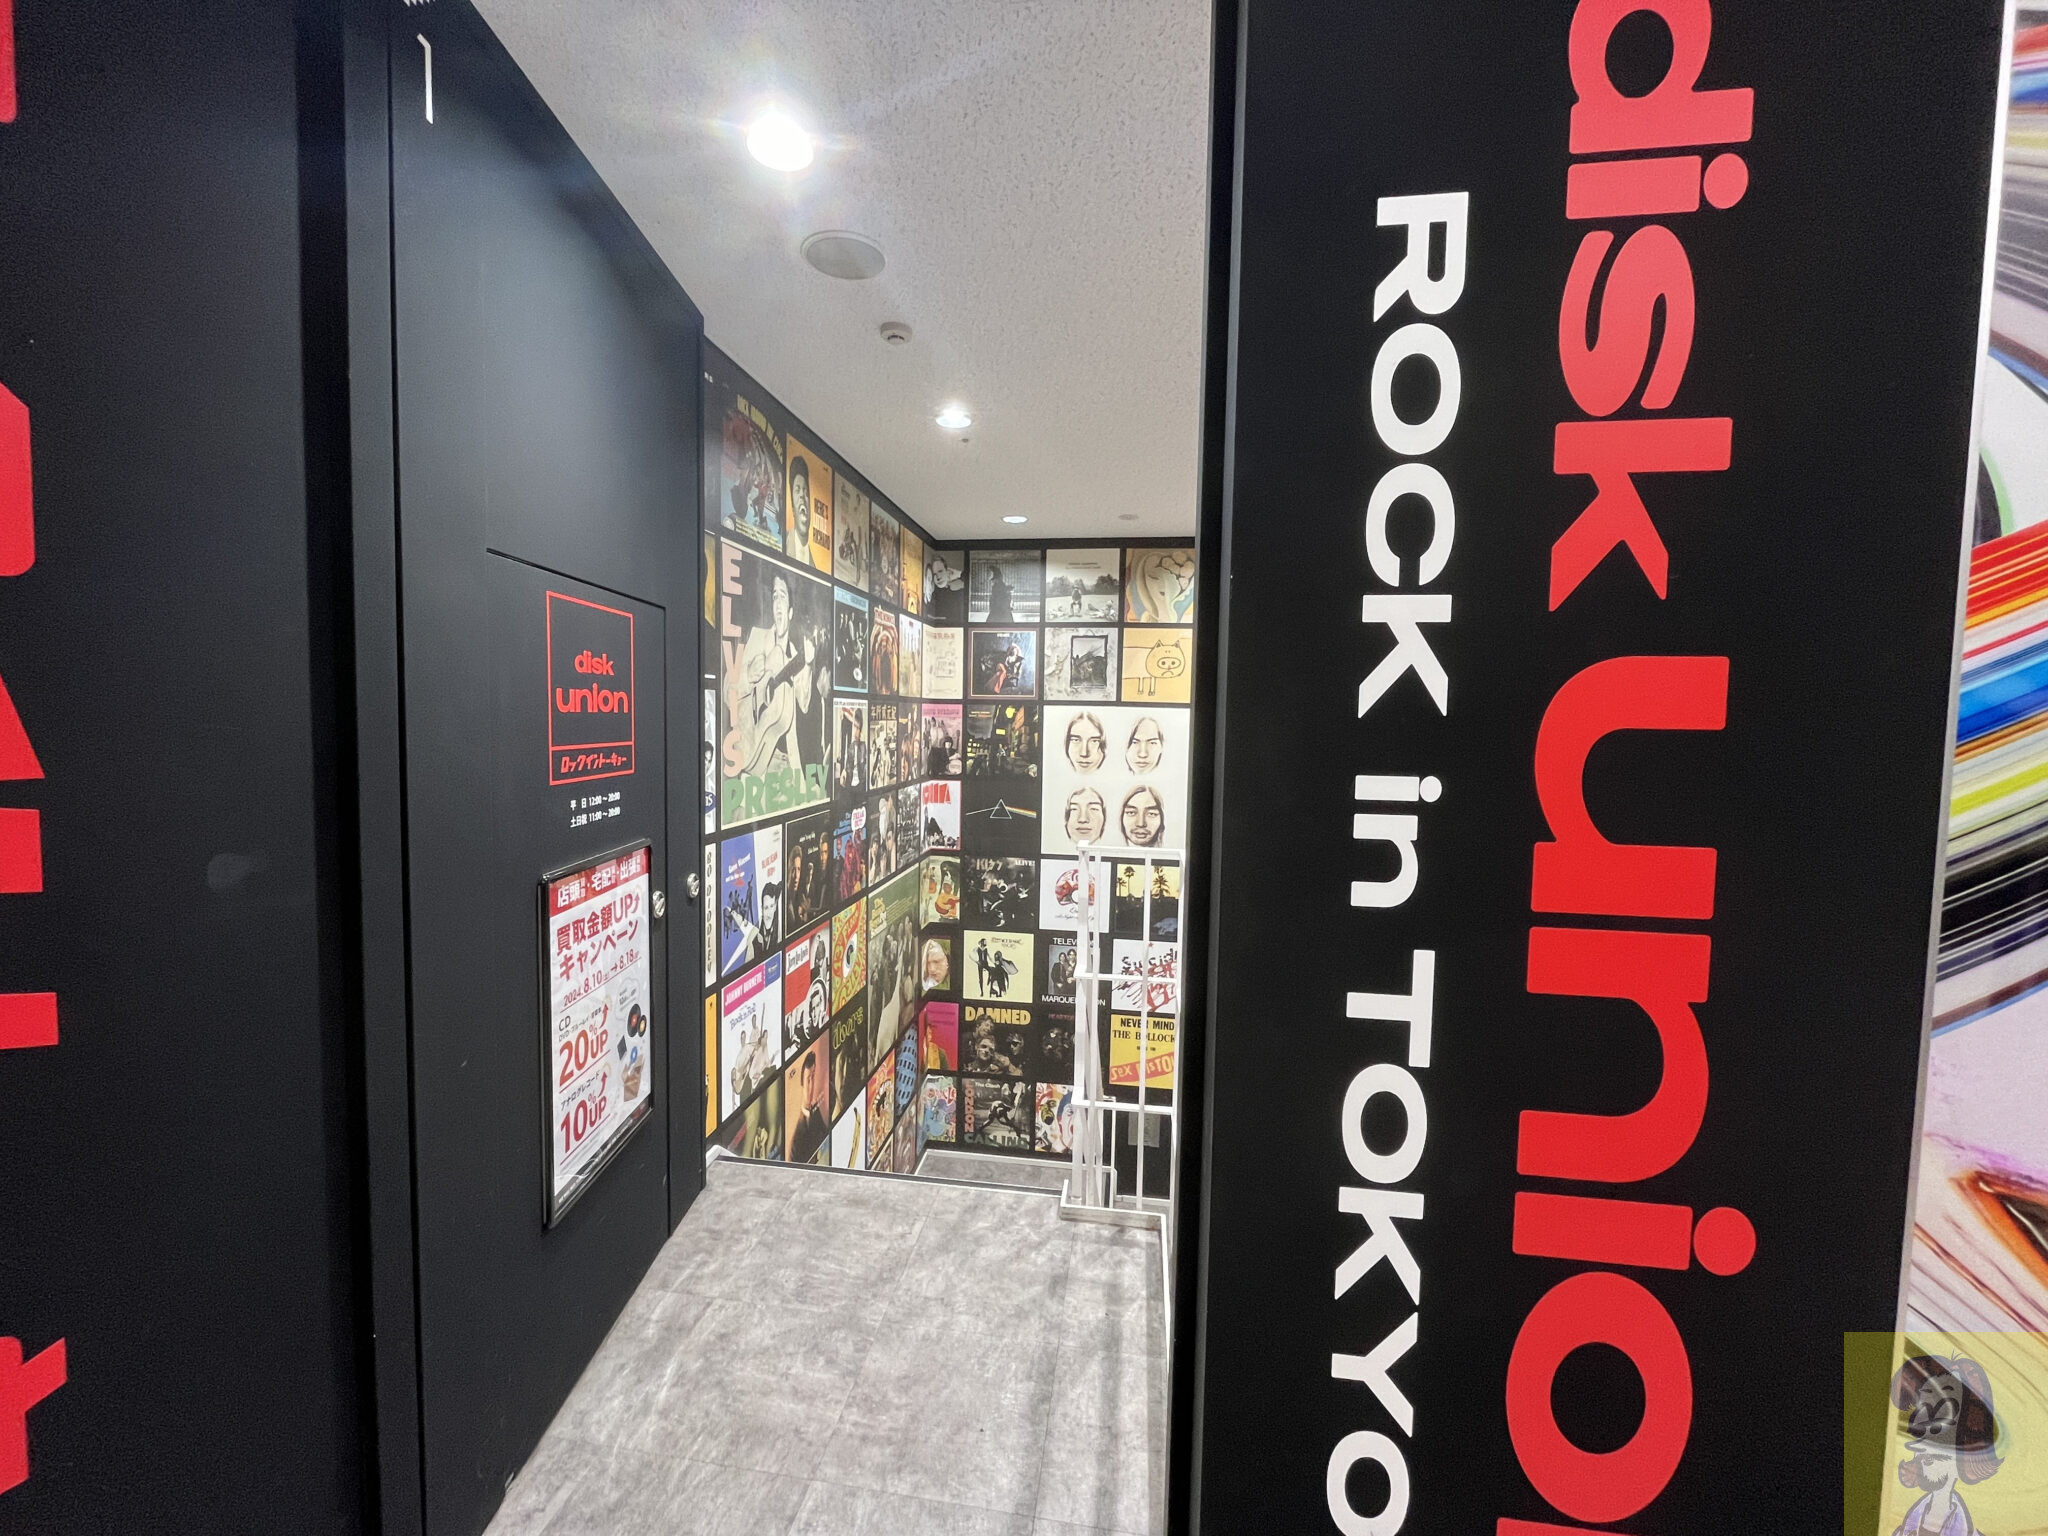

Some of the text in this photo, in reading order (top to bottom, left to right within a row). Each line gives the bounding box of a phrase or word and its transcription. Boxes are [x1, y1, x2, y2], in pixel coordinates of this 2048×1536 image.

[574, 650, 614, 675] disk
[722, 543, 744, 778] ELVIS
[556, 683, 629, 713] union
[1496, 0, 1756, 1536] disk unio
[723, 763, 829, 825] PRESLEY
[976, 858, 1003, 871] KISS
[1327, 192, 1470, 1536] ROCK in TOKYO
[560, 920, 638, 982] キャンペーン
[1053, 937, 1077, 946] TELEV
[725, 984, 743, 1007] JOHNNY
[1041, 994, 1076, 1004] MARQUE
[559, 1015, 571, 1032] CD
[833, 1006, 864, 1050] doors
[965, 1006, 1031, 1026] DAMNED
[1120, 1017, 1175, 1030] NEVE MIND
[1112, 1029, 1175, 1043] THE BLLOCK
[964, 1079, 975, 1133] LONDON
[964, 1132, 1030, 1150] CALLING
